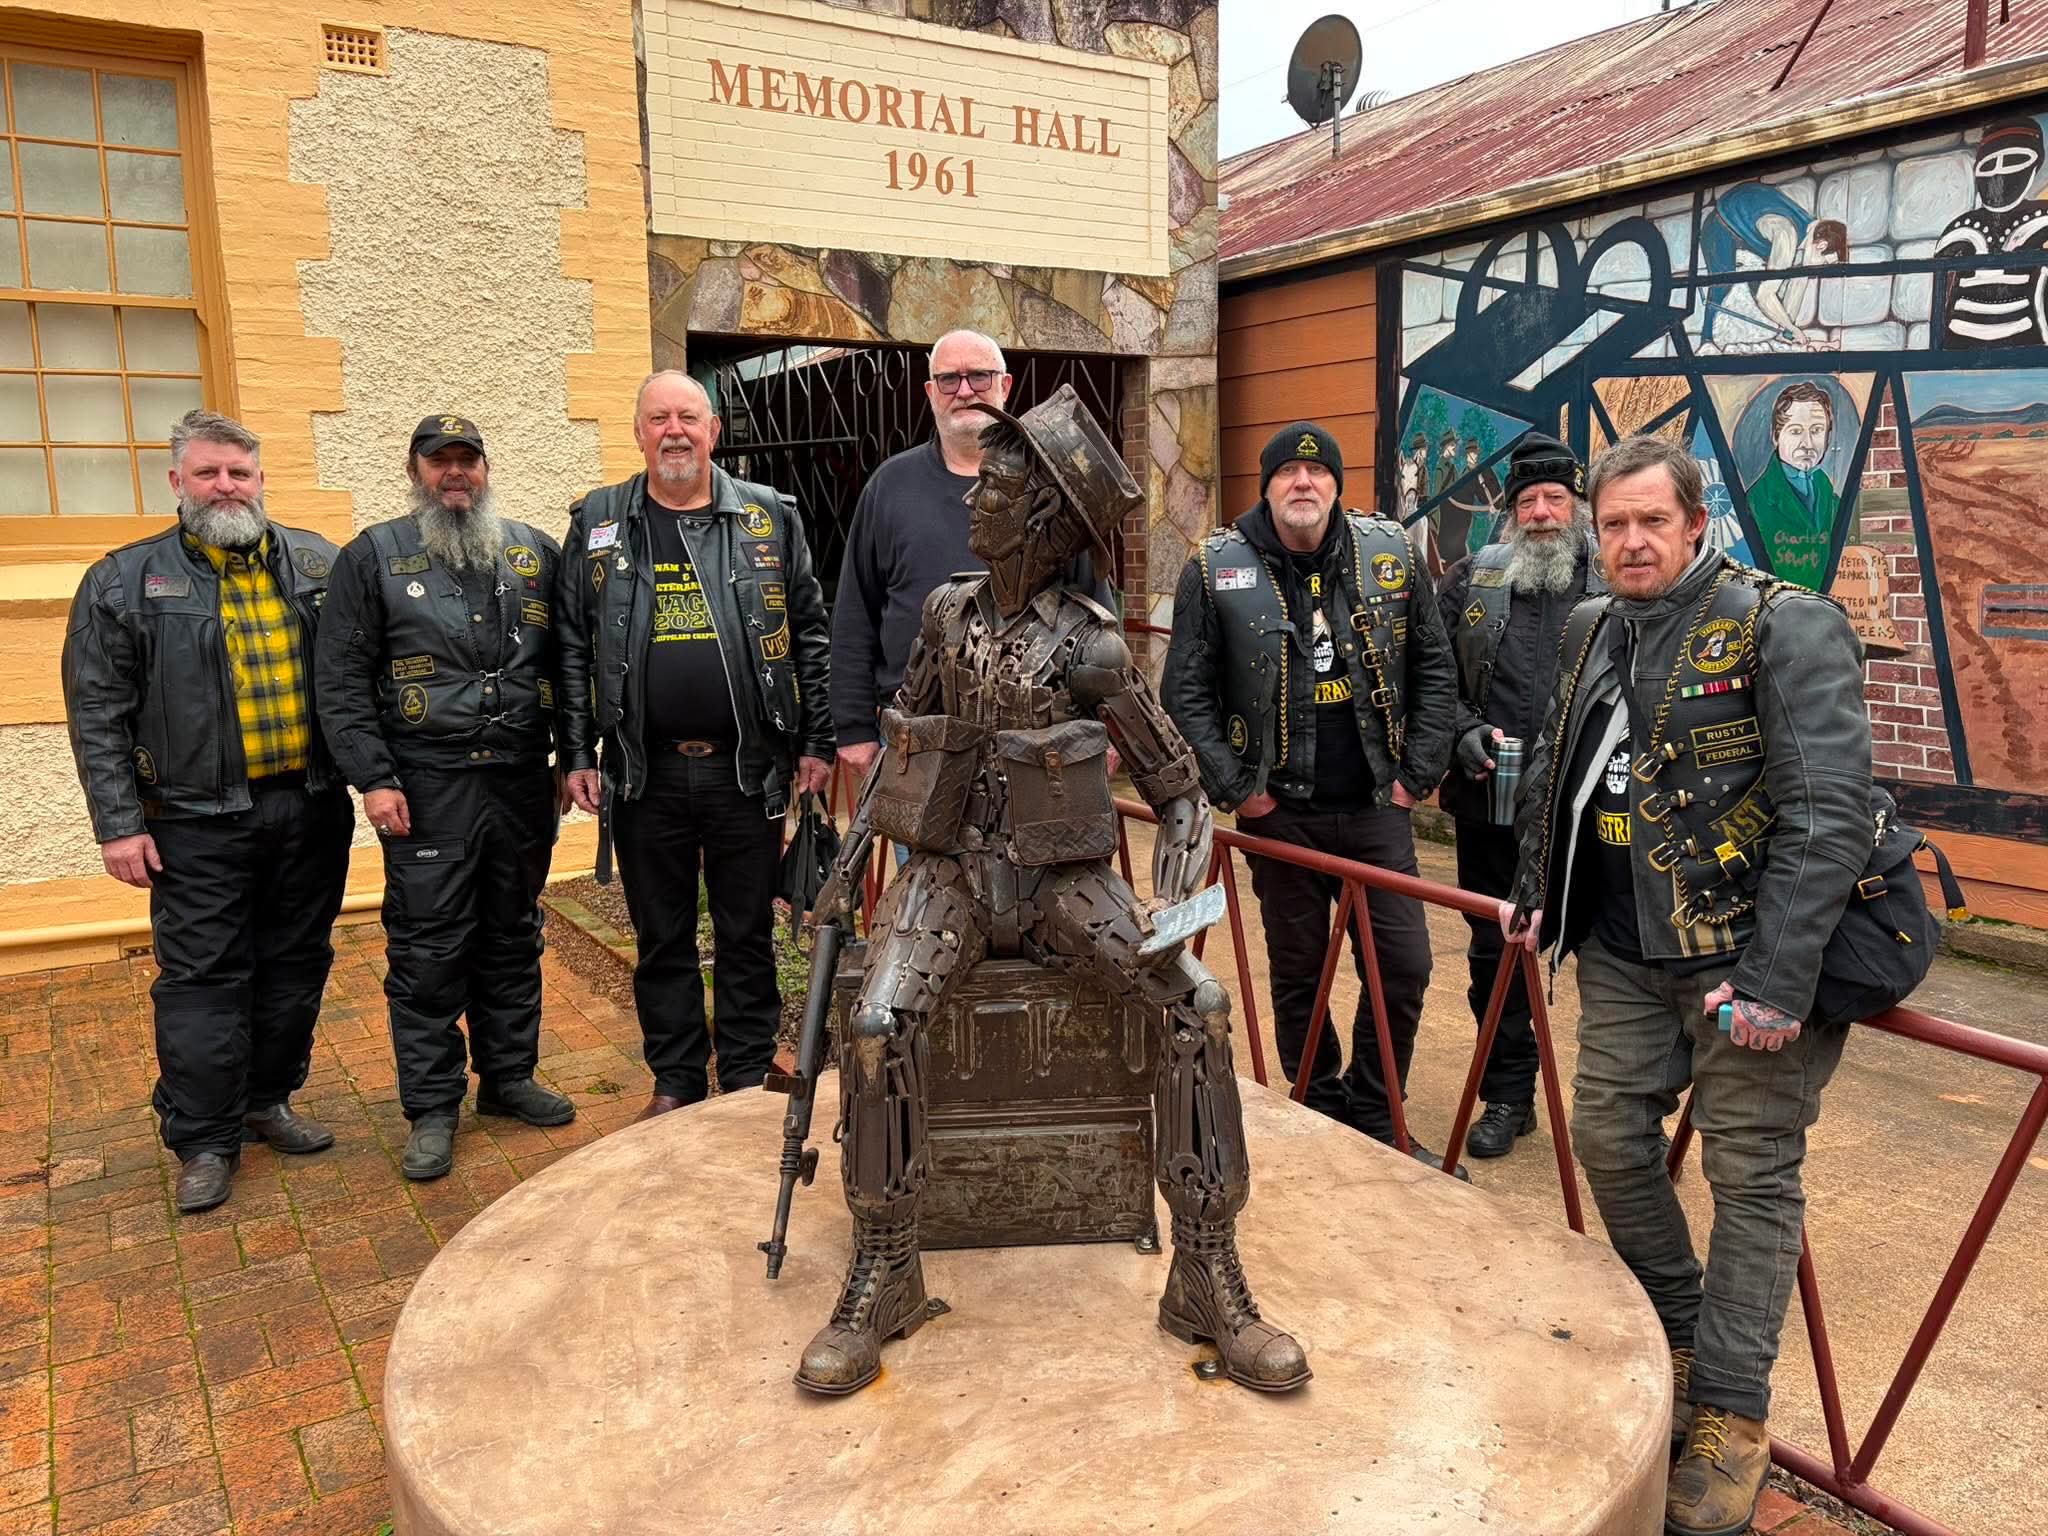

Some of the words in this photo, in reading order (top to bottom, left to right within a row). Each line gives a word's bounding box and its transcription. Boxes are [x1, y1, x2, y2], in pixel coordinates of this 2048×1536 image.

[707, 58, 986, 139] MEMORIAL
[1011, 105, 1121, 157] HALL
[885, 150, 979, 198] 1961
[1706, 725, 1745, 741] RUSTY
[1706, 745, 1753, 762] FEDERAL
